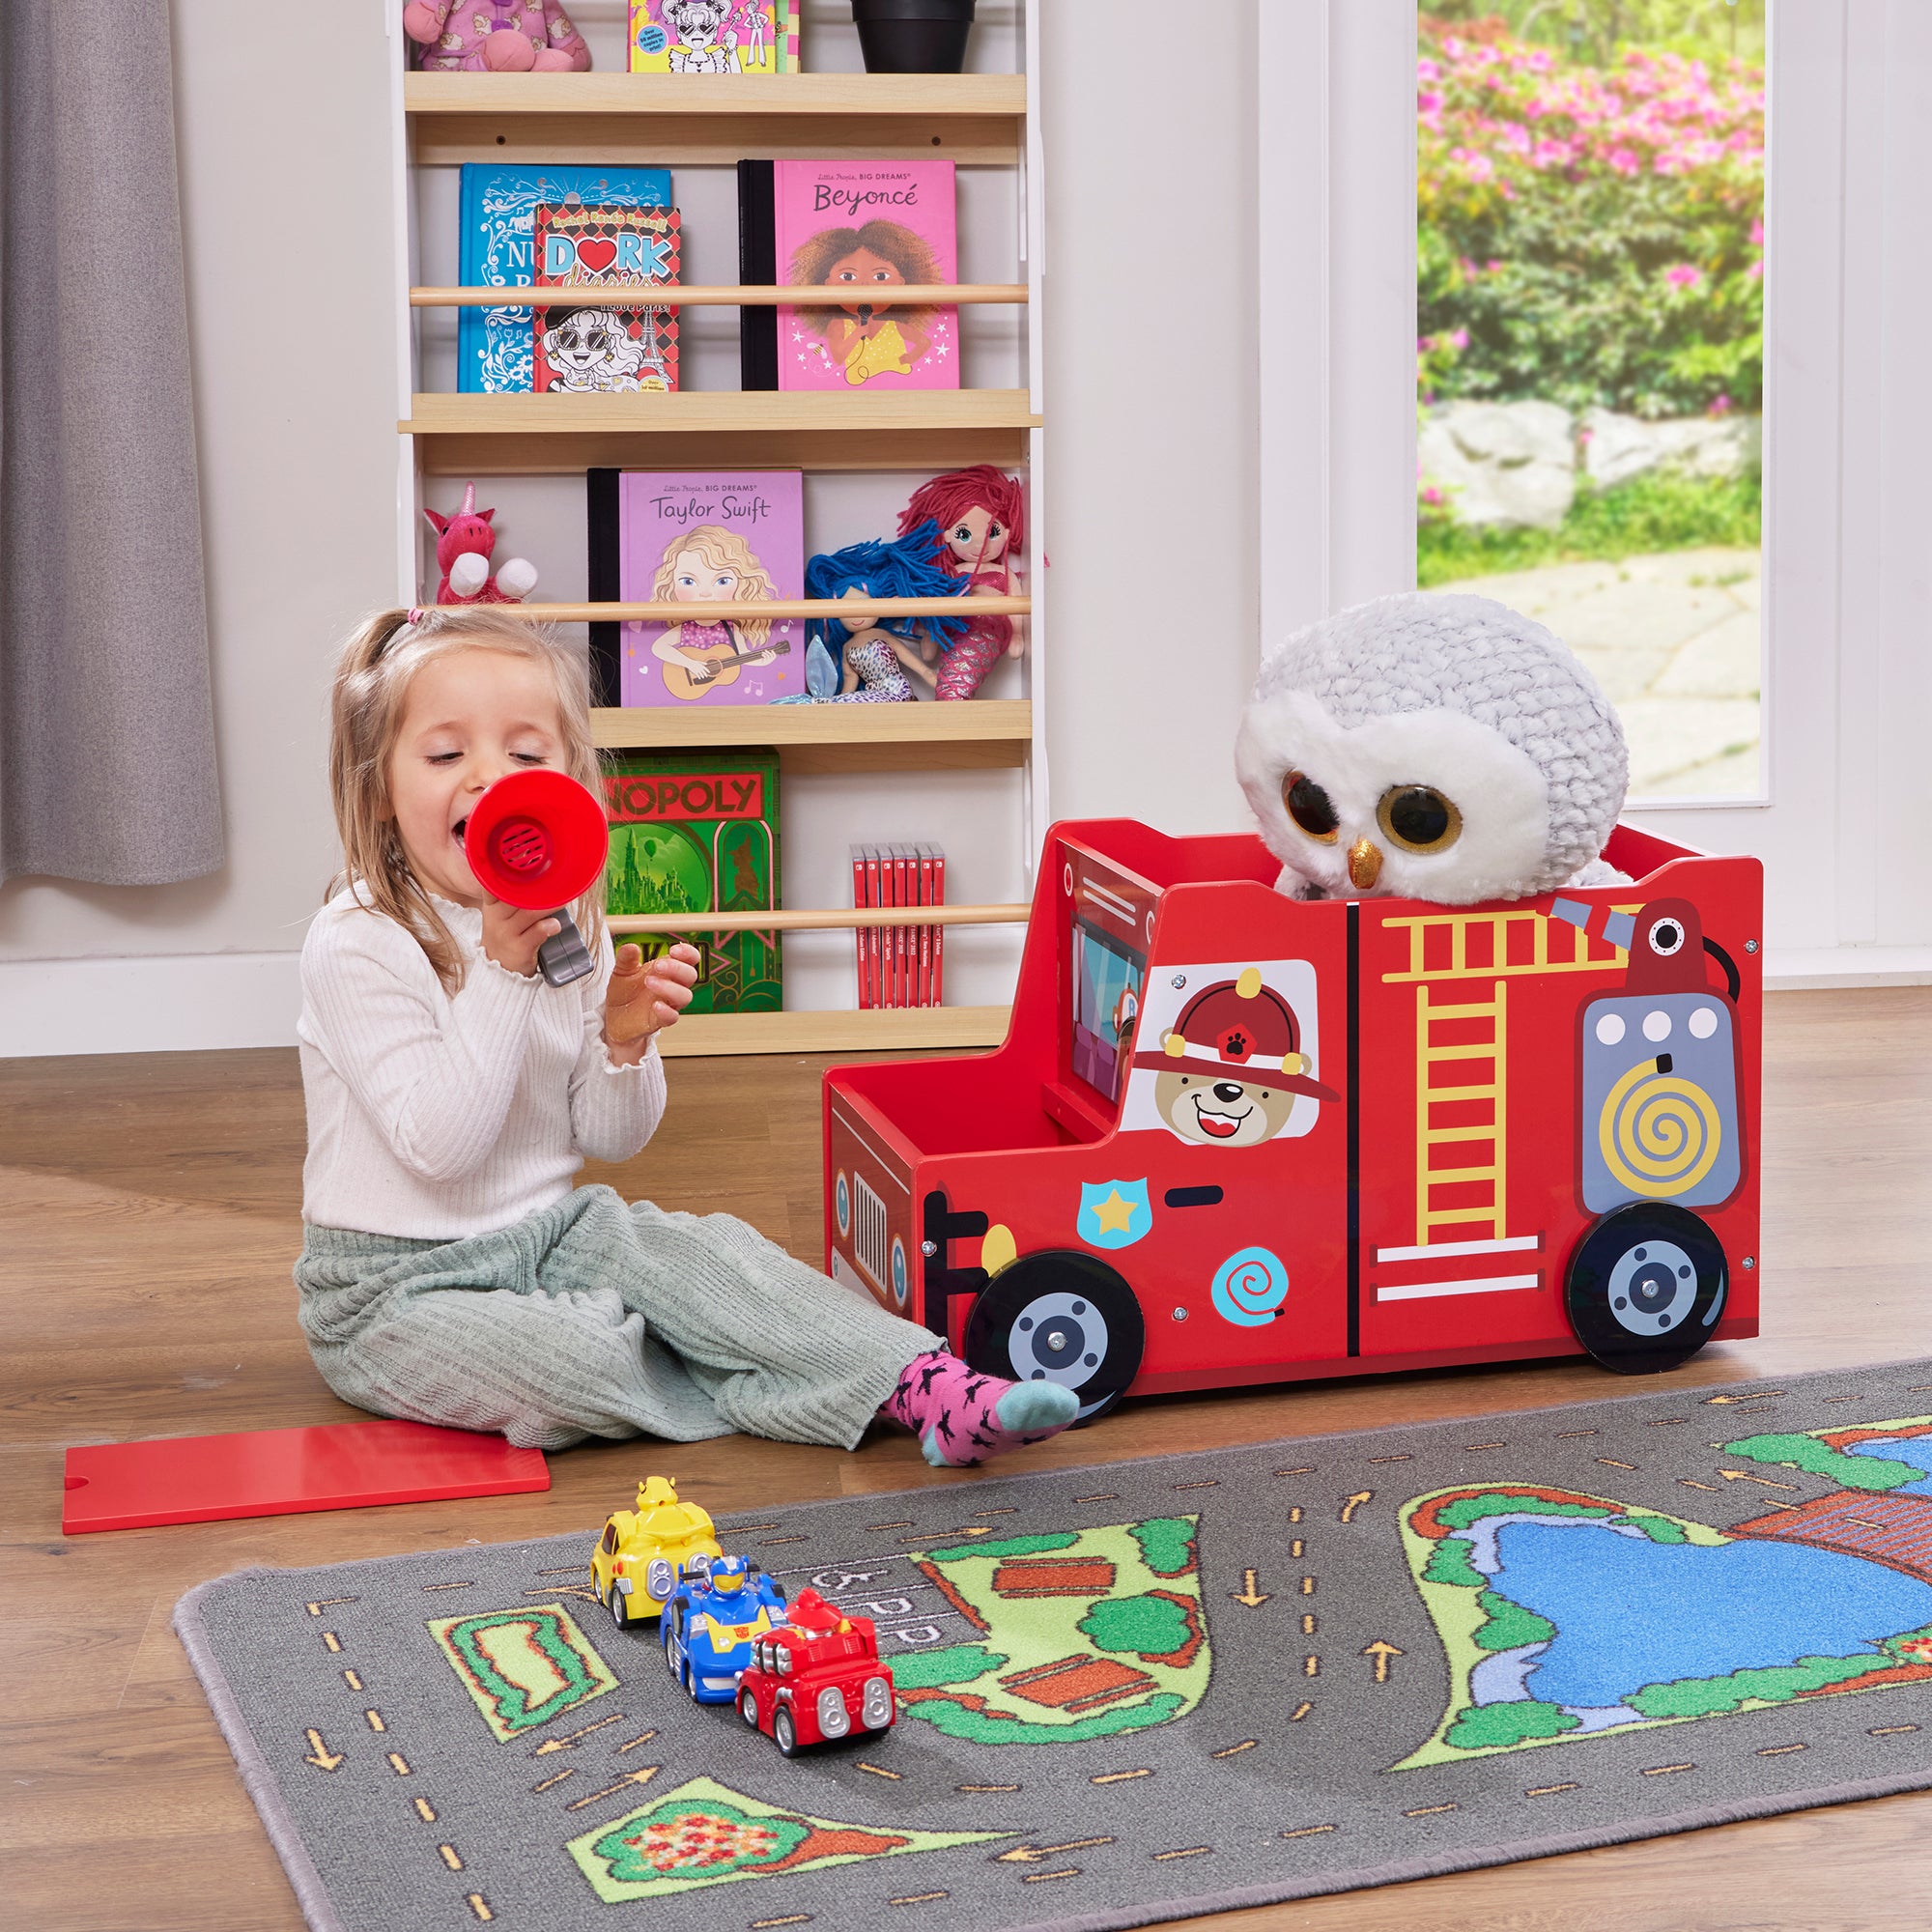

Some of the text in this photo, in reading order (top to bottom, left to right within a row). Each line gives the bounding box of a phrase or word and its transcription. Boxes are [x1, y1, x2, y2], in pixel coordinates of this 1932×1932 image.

[812, 183, 919, 216] Beyoncé
[552, 211, 668, 233] Rachel Renée Russell
[562, 262, 660, 287] diaries
[649, 496, 772, 525] Taylor Swift
[609, 779, 756, 815] NOPOLY
